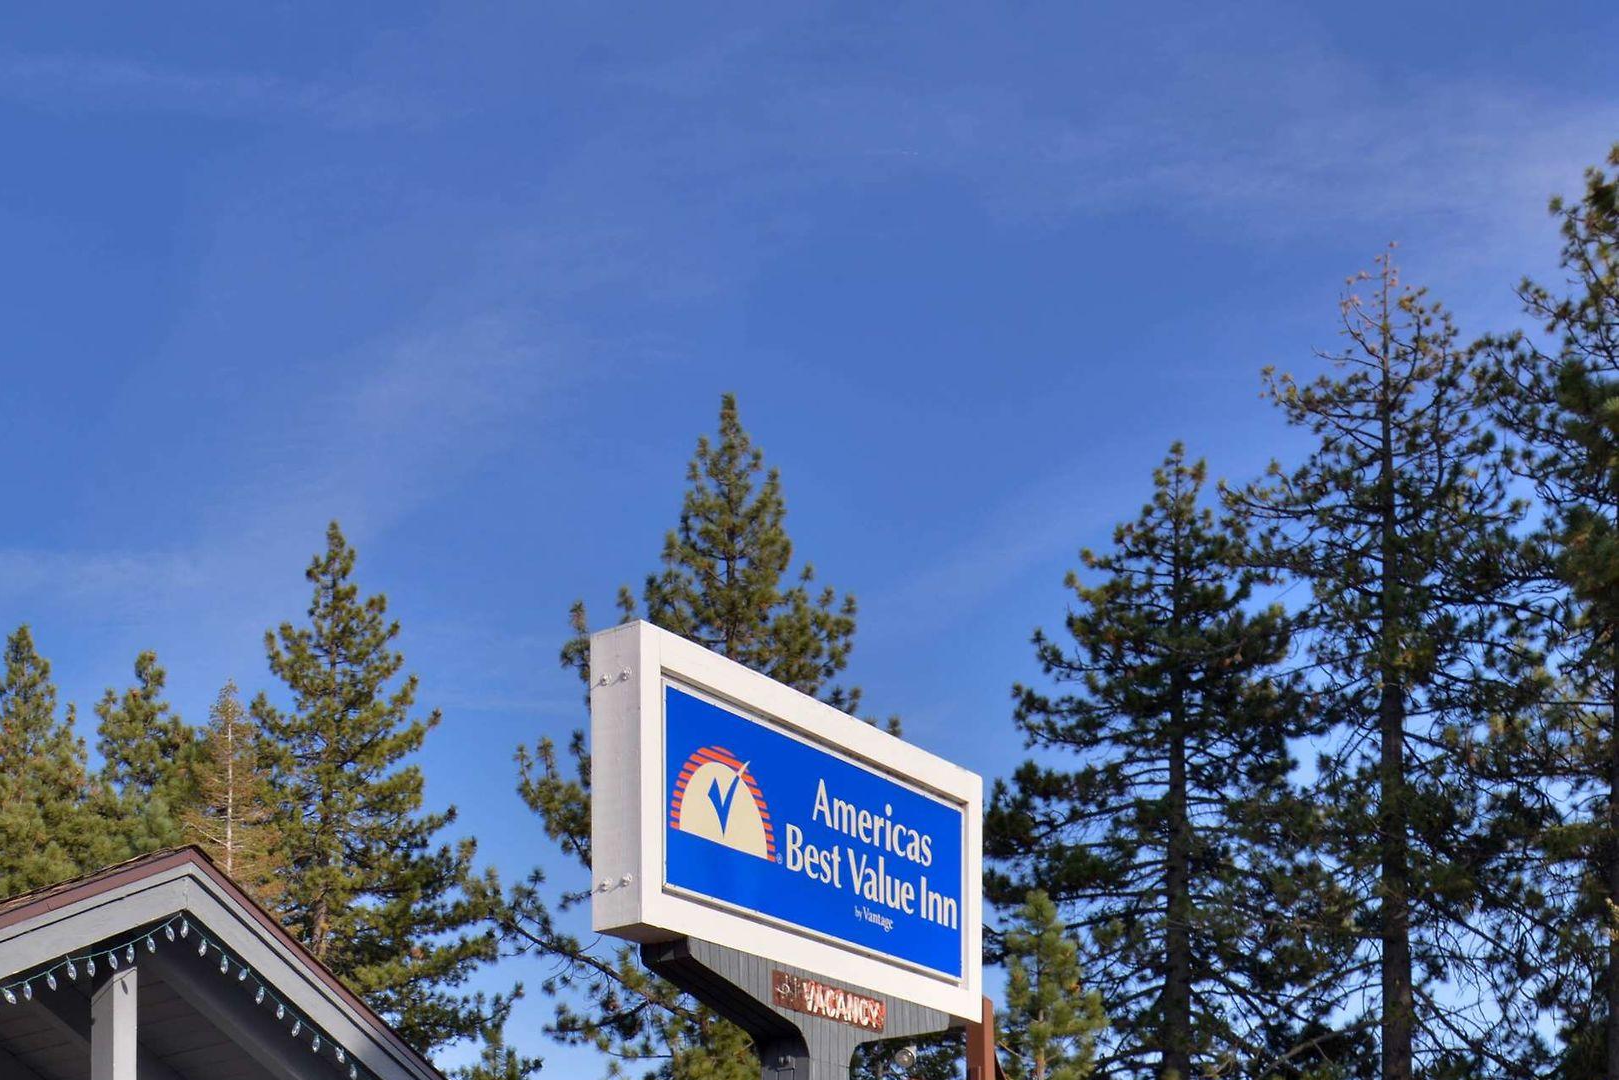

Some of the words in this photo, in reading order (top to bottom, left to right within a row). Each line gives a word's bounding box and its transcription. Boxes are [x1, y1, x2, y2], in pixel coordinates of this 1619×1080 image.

[812, 778, 932, 867] Americas
[786, 823, 842, 888] Best
[847, 847, 915, 915] Value
[920, 875, 958, 930] Inn
[854, 905, 863, 922] by
[863, 906, 894, 933] Vantage
[802, 980, 884, 1028] VACANCY
